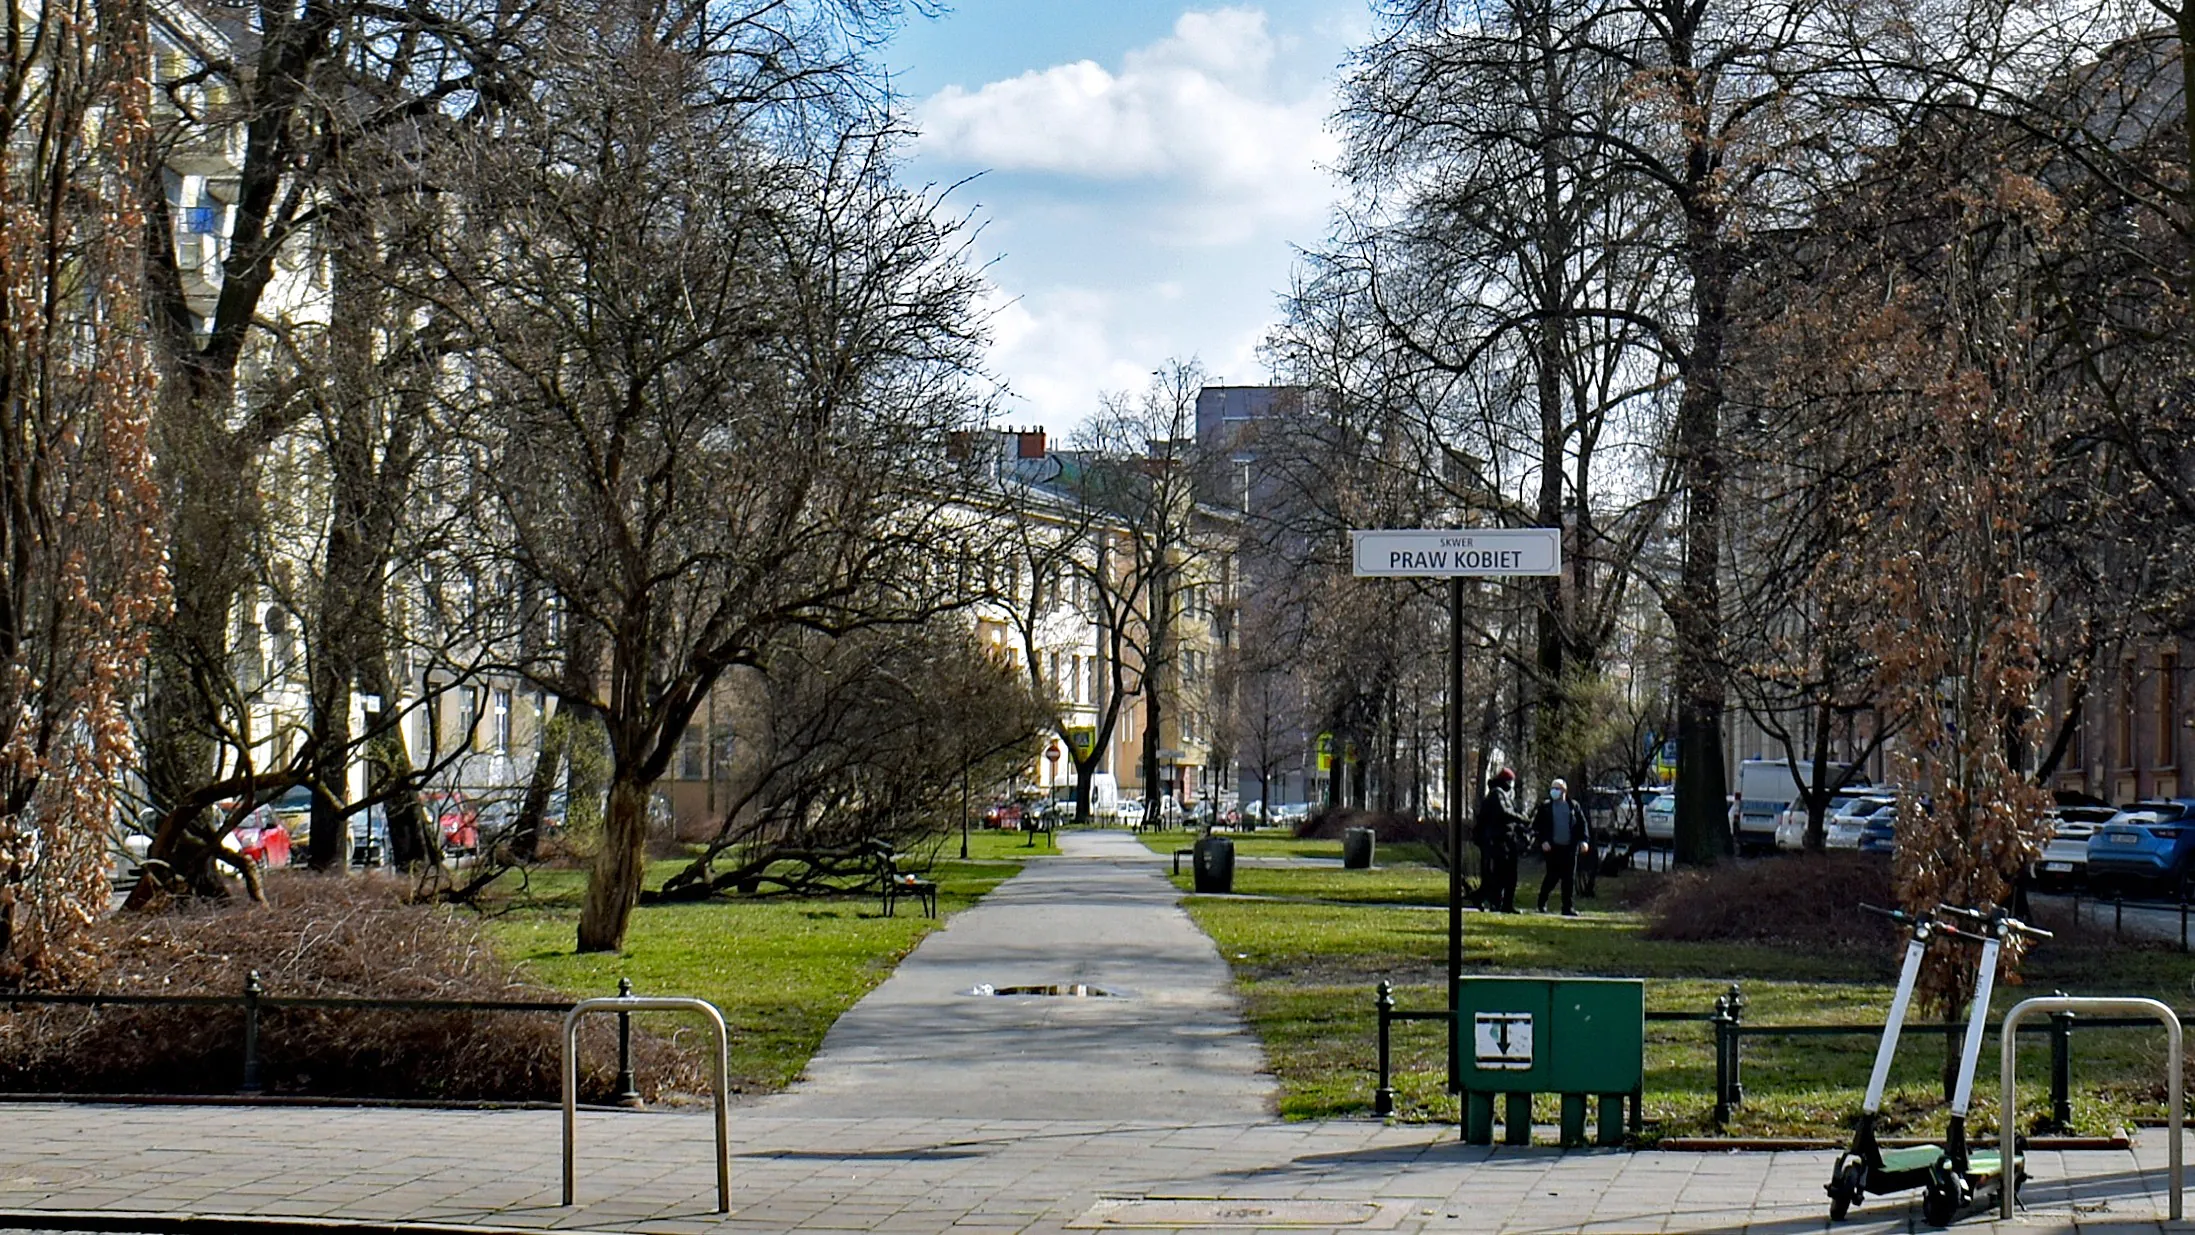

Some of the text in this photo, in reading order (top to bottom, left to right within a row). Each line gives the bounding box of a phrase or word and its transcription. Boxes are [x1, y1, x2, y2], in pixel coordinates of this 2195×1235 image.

[1440, 538, 1474, 548] SKWER
[1390, 551, 1522, 568] PRAW KOBIET
